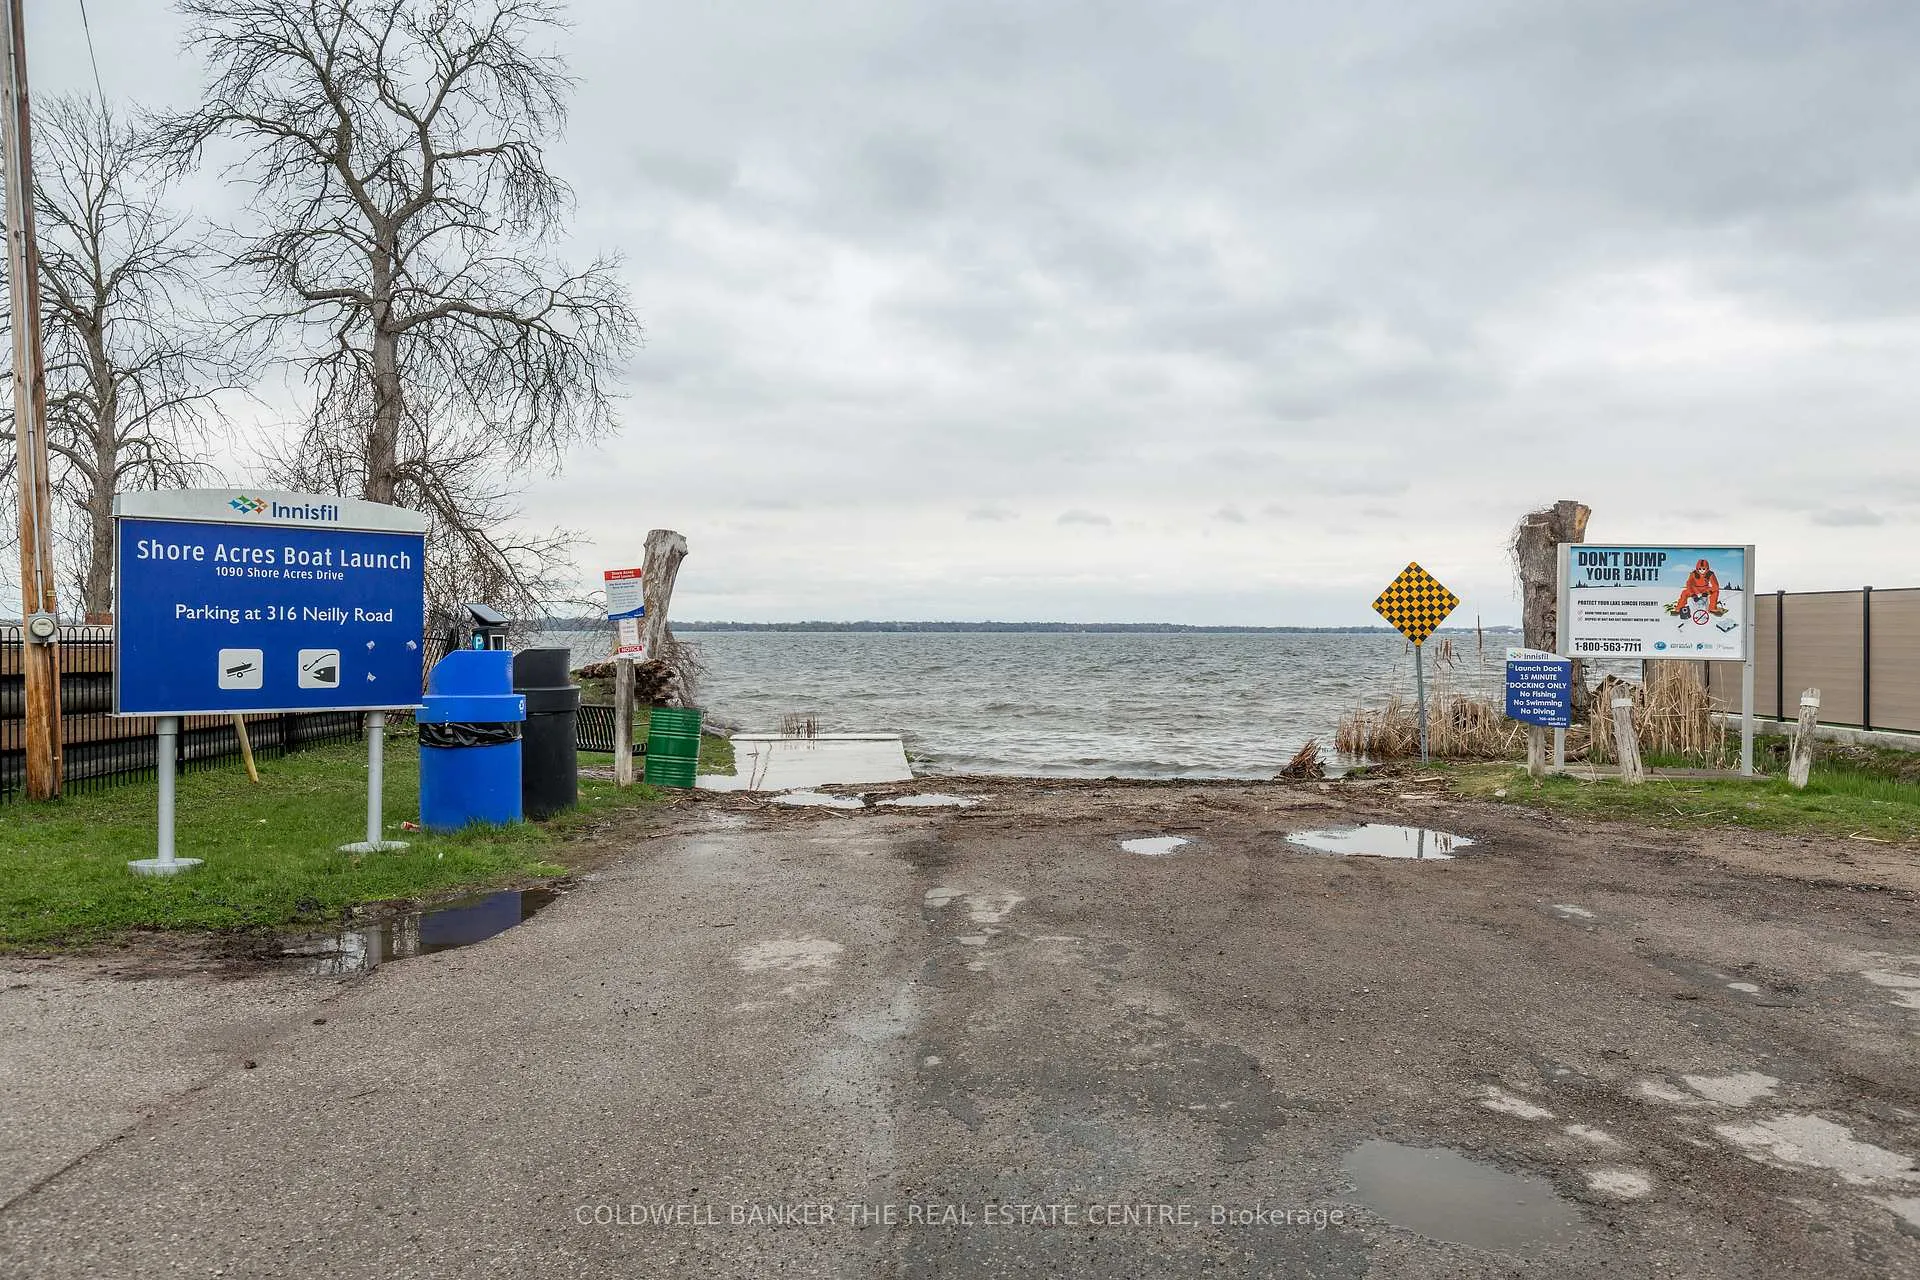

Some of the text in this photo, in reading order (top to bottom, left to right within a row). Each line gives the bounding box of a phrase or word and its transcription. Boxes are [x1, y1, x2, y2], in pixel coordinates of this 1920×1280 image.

[272, 502, 338, 521] Innisfil
[136, 540, 411, 569] Shore Acres Boat Launch
[1578, 551, 1667, 568] DON'T DUMP
[215, 567, 344, 581] 1090 Shore Acres Drive
[1586, 568, 1659, 581] YOUR BAIT!
[175, 604, 393, 625] Parking at 316 Neilly Road
[476, 636, 483, 649] P
[1575, 642, 1642, 652] 1-800-563-7711
[1526, 699, 1563, 707] Swimming
[1533, 708, 1556, 716] Diving
